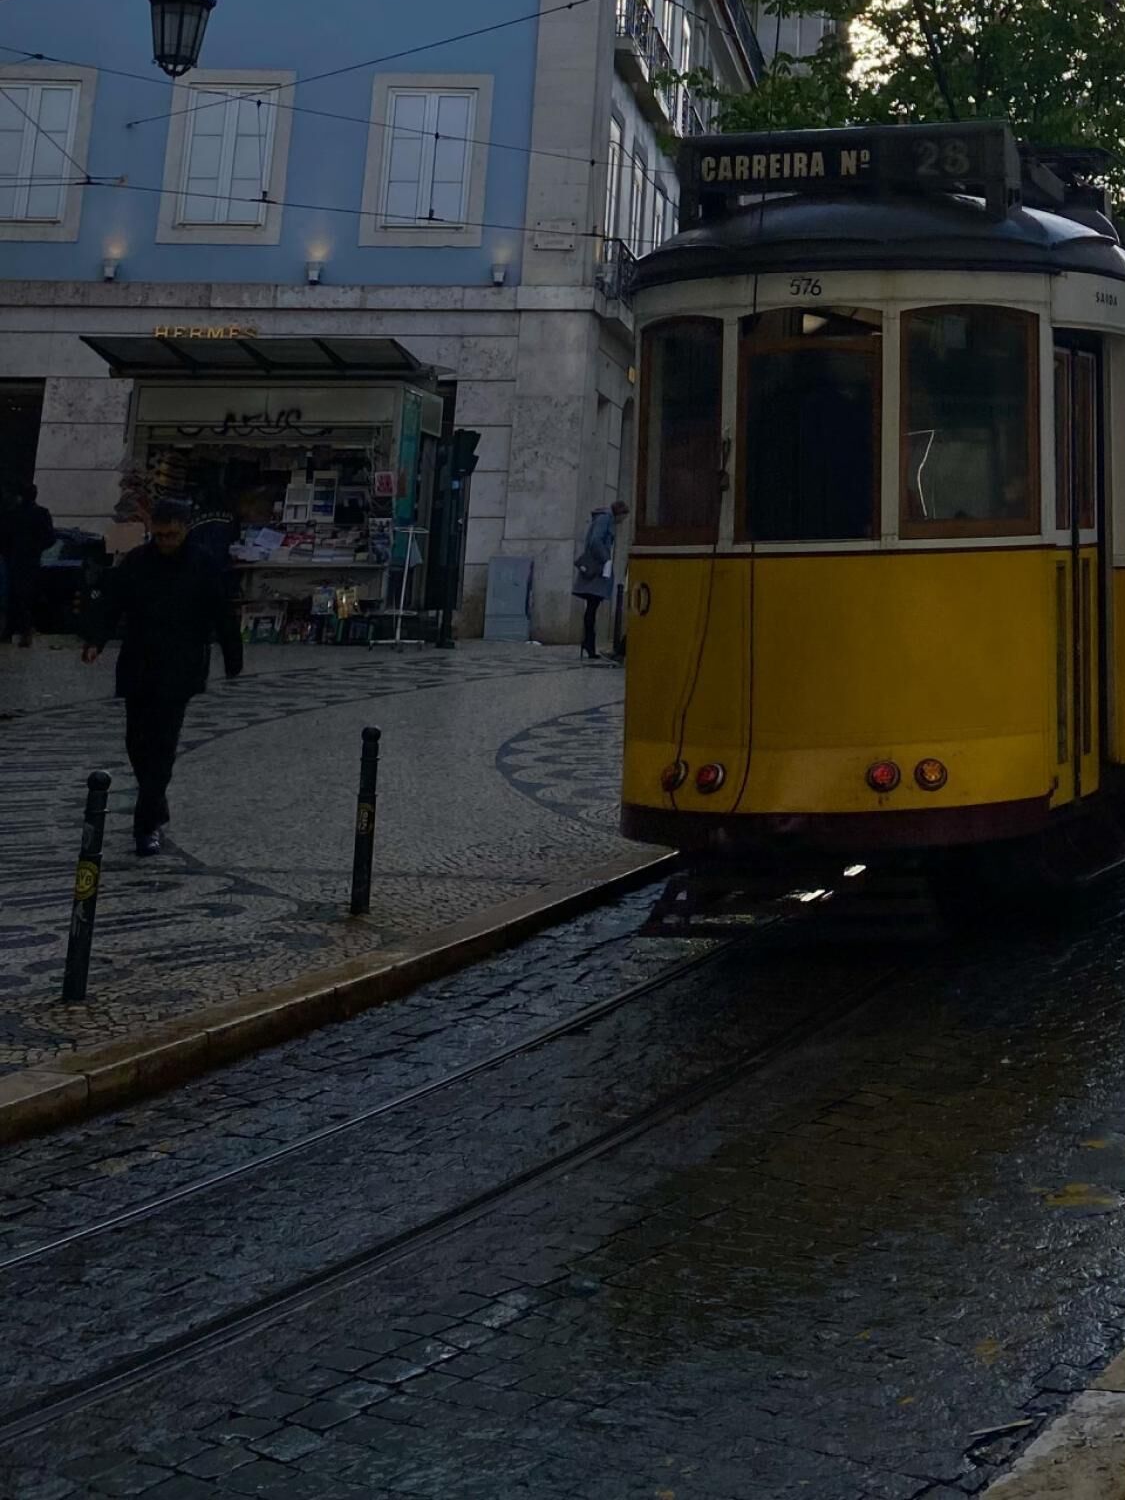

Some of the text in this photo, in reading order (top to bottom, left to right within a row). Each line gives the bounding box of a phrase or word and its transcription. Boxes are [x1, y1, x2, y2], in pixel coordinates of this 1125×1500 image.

[701, 138, 971, 182] CARREIRA Nº 28
[789, 277, 823, 297] 576
